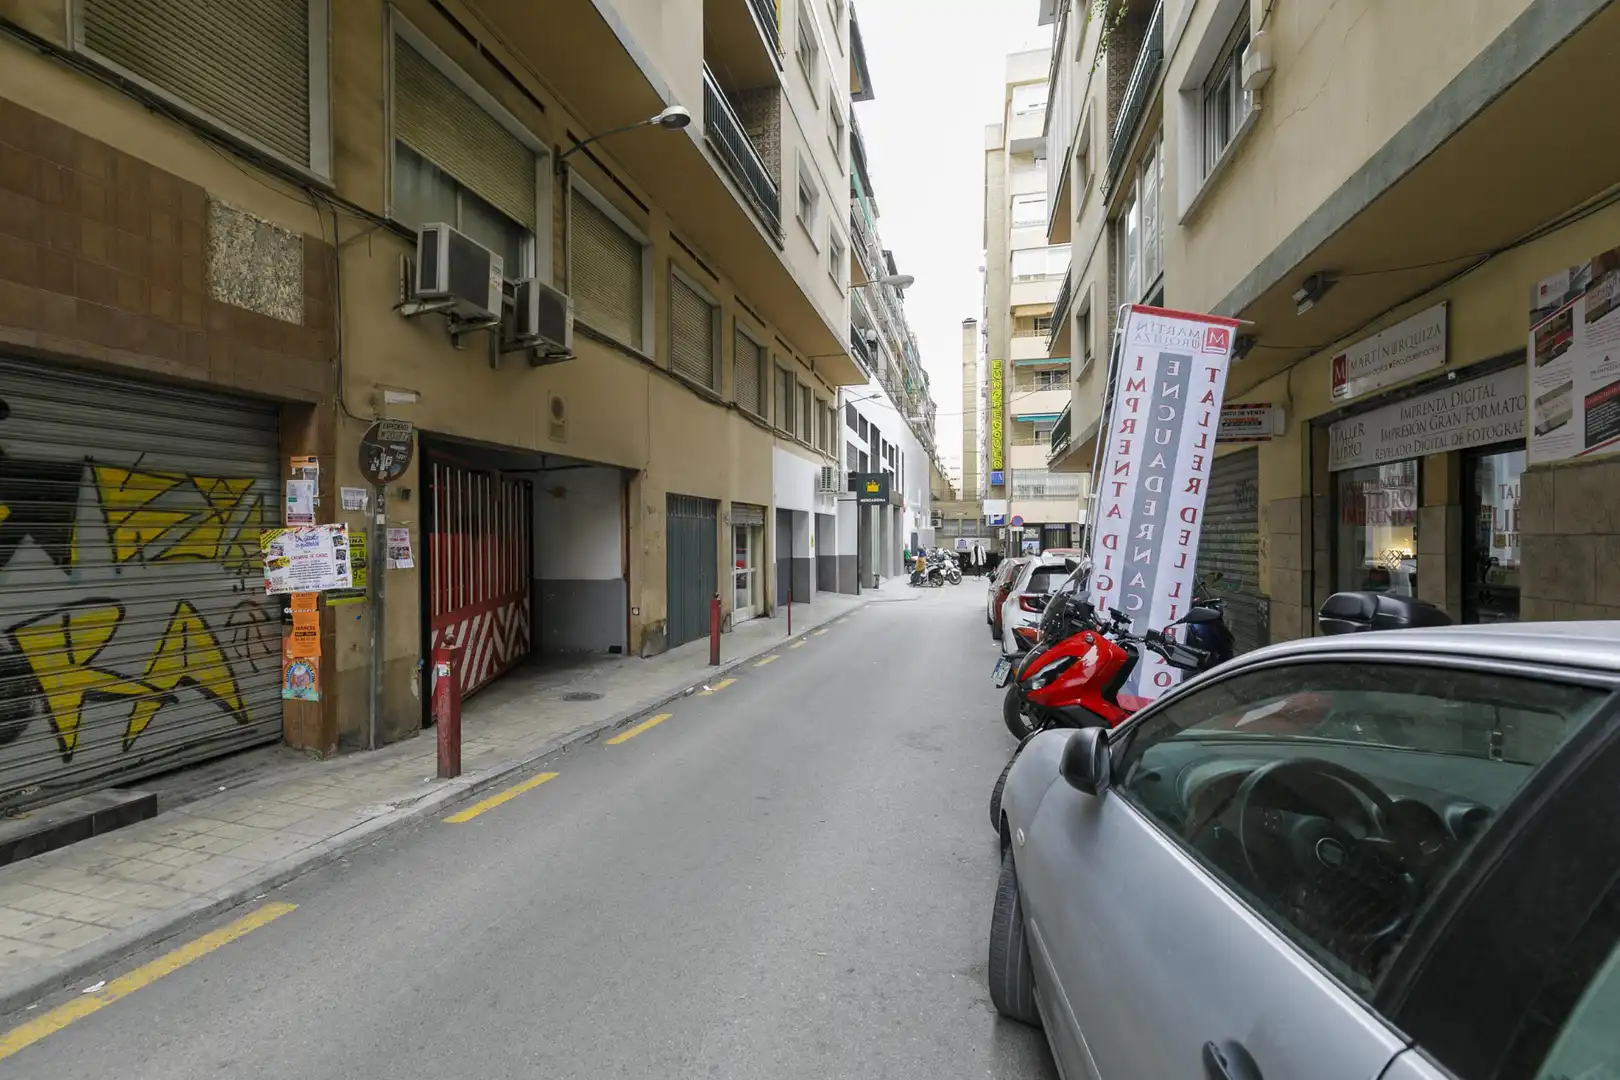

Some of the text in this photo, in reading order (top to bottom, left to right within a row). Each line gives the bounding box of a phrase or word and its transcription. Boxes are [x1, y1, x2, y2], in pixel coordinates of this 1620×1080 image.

[1401, 382, 1497, 420] IMPRENTA DIGITAL
[1429, 411, 1463, 430] GRAN
[1465, 395, 1527, 424] FORMATO
[1332, 422, 1365, 443] TALLER
[1335, 441, 1362, 461] LIBRO
[1375, 444, 1412, 460] REVELADO
[1414, 435, 1448, 452] DIGITAL
[1451, 432, 1464, 445] DE
[1368, 489, 1412, 509] LIBRO
